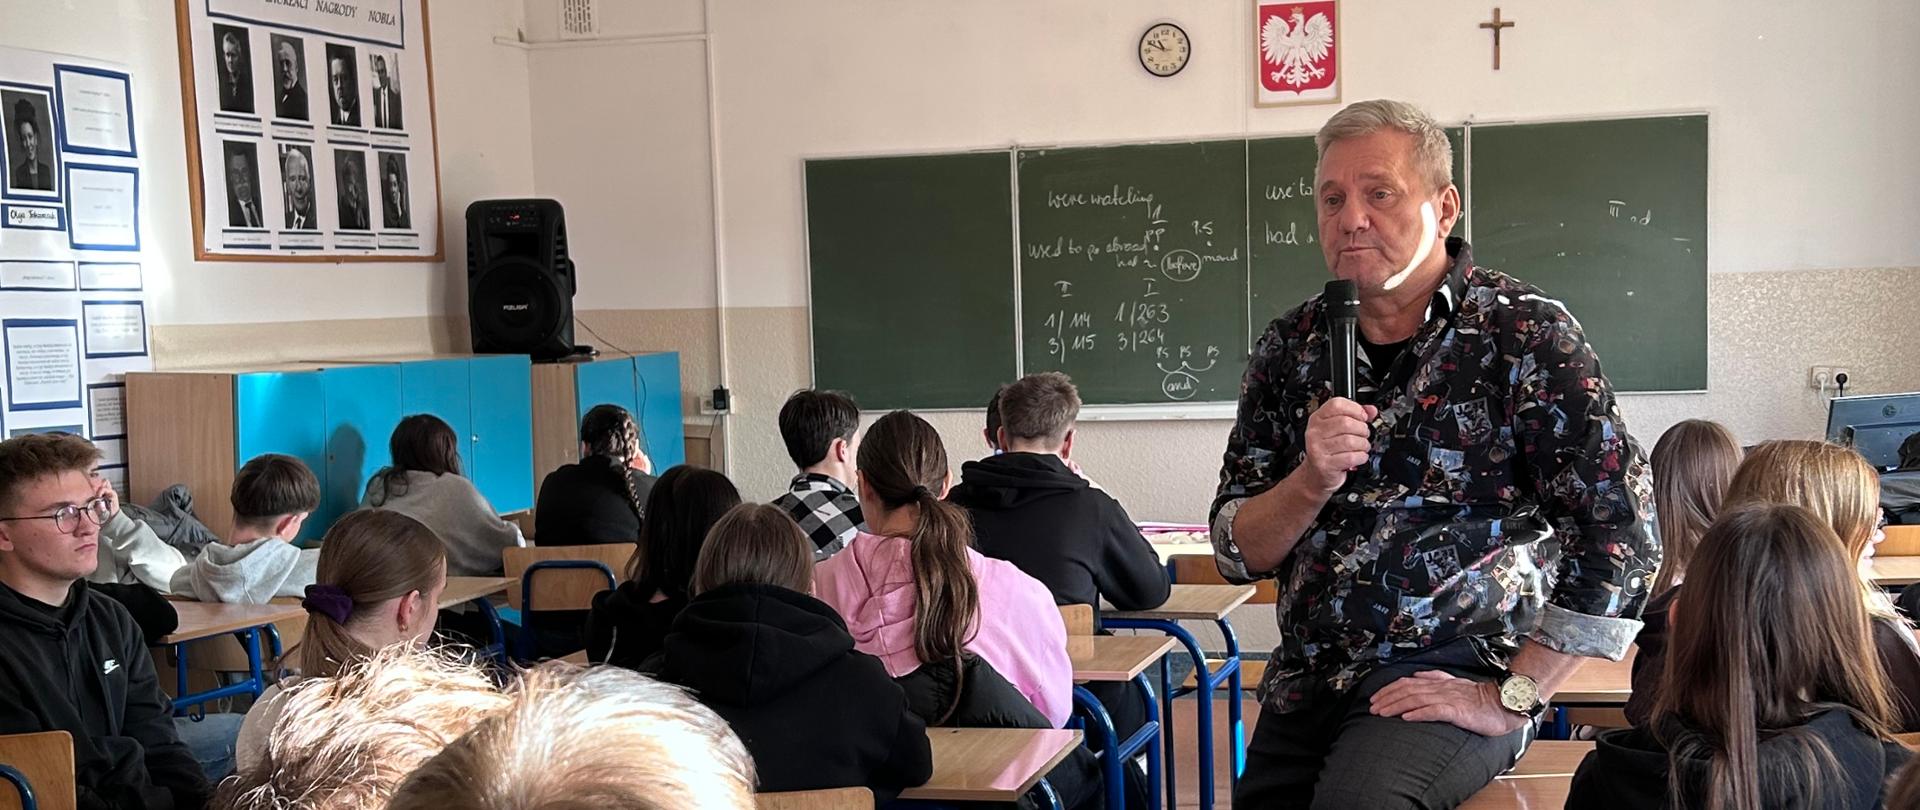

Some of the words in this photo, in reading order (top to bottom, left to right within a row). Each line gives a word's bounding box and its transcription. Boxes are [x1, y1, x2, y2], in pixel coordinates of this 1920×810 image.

[265, 0, 309, 10] REACI
[315, 1, 358, 18] NAGRODY
[367, 10, 396, 26] NOBLA
[1299, 177, 1313, 196] to
[1048, 190, 1087, 209] were
[1090, 184, 1154, 218] watching
[10, 209, 26, 223] Olga
[1028, 236, 1063, 259] used
[1068, 238, 1083, 254] to
[1166, 376, 1193, 393] and
